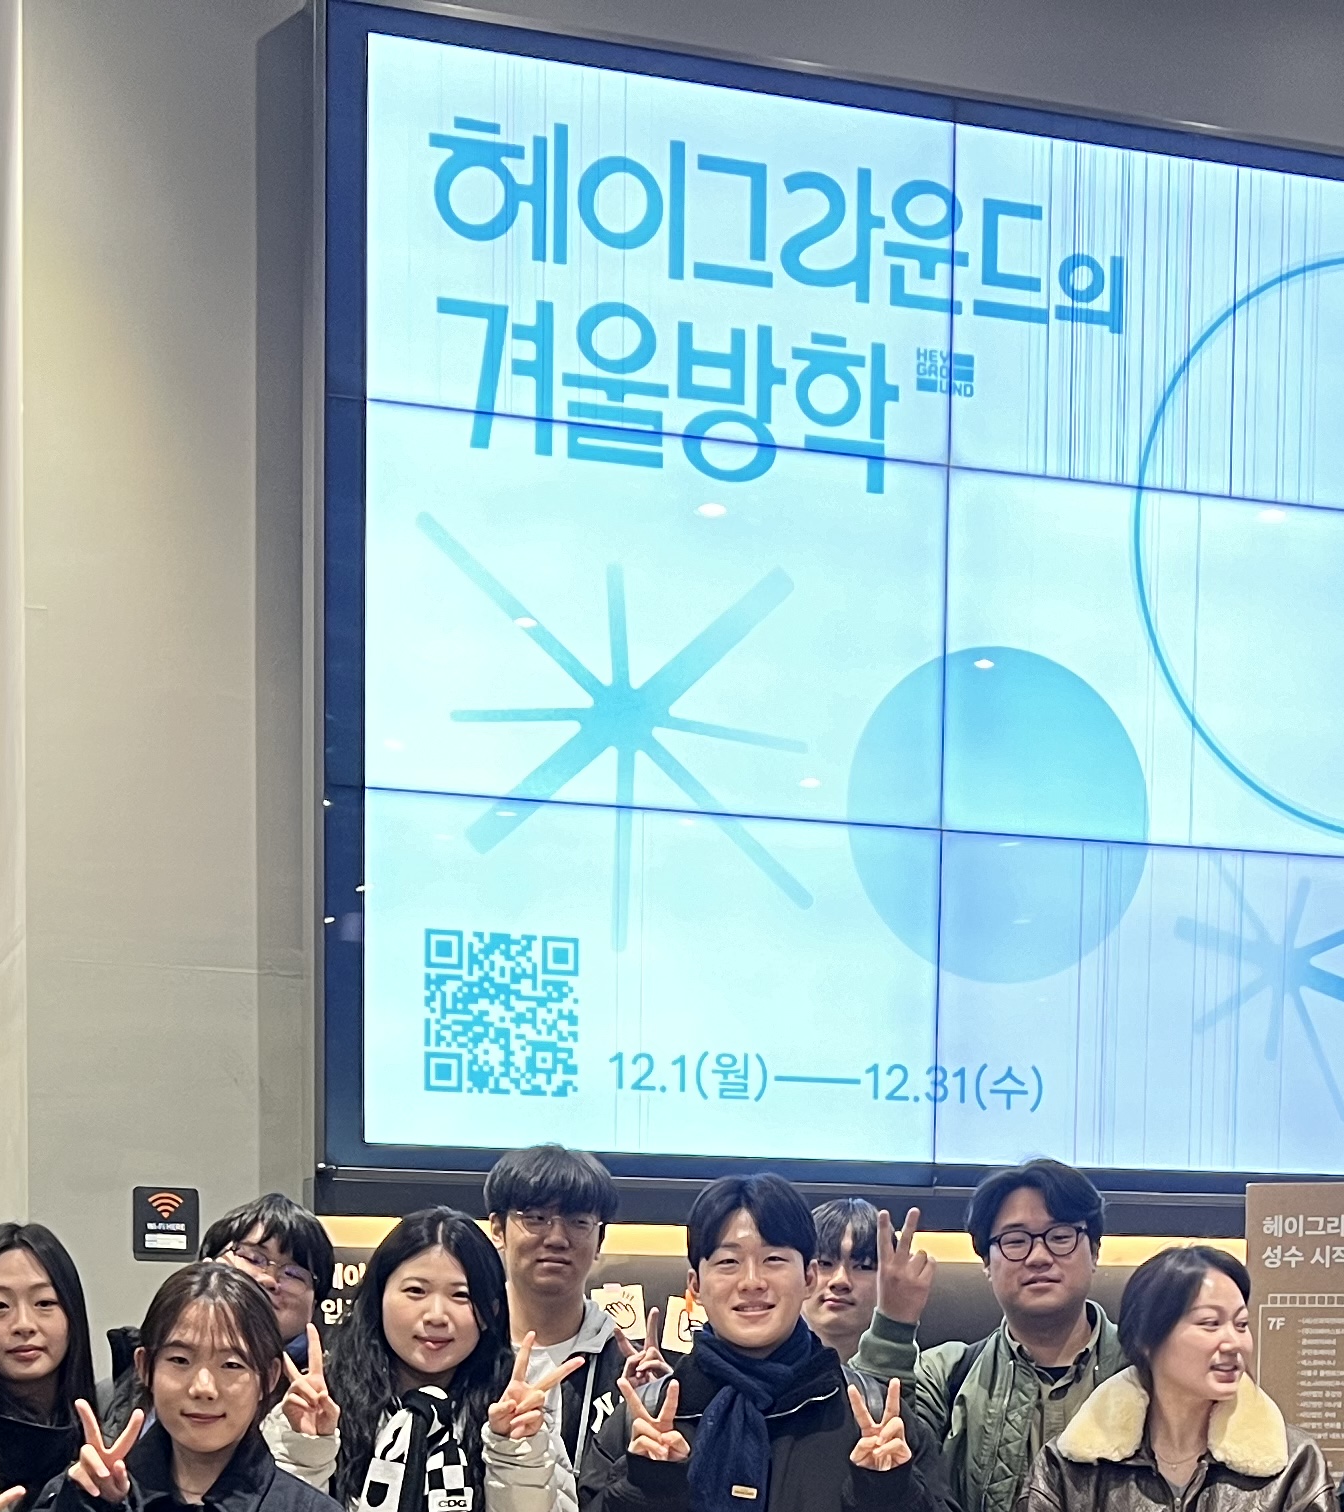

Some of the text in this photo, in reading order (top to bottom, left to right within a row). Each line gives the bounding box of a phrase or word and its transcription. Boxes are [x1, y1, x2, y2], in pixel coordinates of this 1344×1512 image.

[429, 116, 1125, 334] 헤이그라운드의
[916, 347, 950, 364] HEY
[437, 295, 899, 495] 겨울방학
[1261, 1245, 1305, 1268] 성수
[1267, 1317, 1286, 1331] 7F
[438, 1499, 467, 1508] CDG
